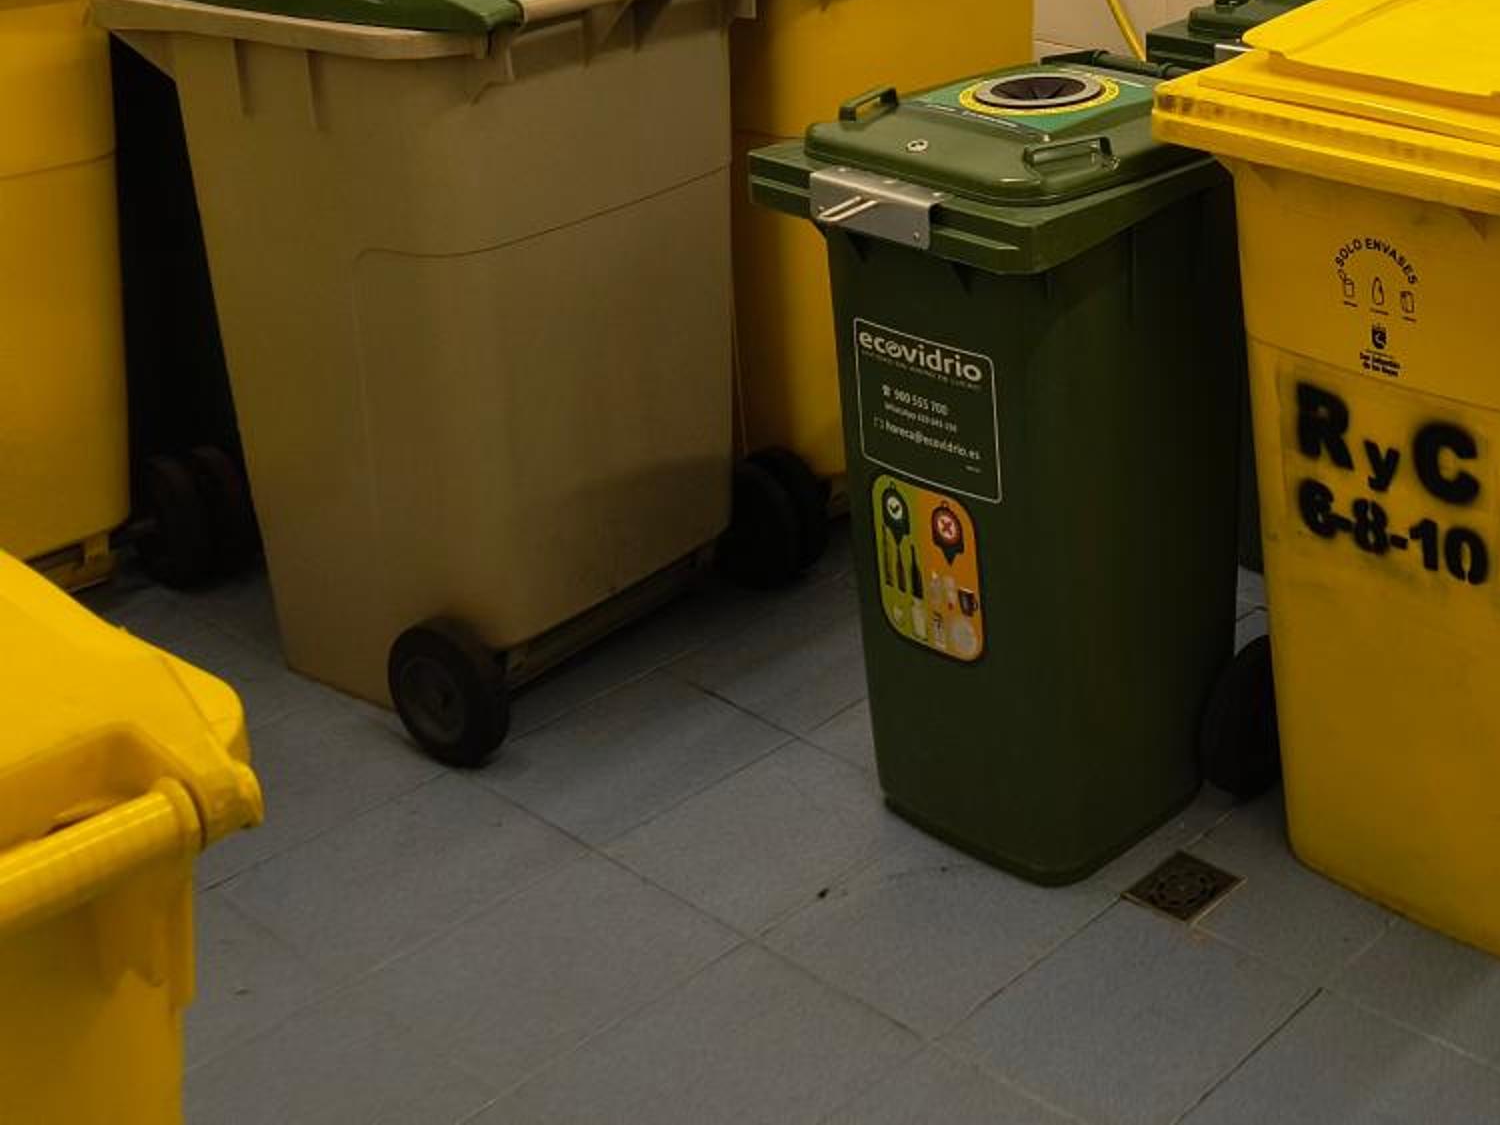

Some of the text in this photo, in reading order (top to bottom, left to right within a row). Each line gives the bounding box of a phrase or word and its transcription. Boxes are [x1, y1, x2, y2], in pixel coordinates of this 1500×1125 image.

[1335, 238, 1418, 285] SOLO ENVASES
[859, 331, 982, 382] ecovidrio
[1295, 382, 1481, 506] R y C
[1298, 479, 1489, 586] 6-8-10
